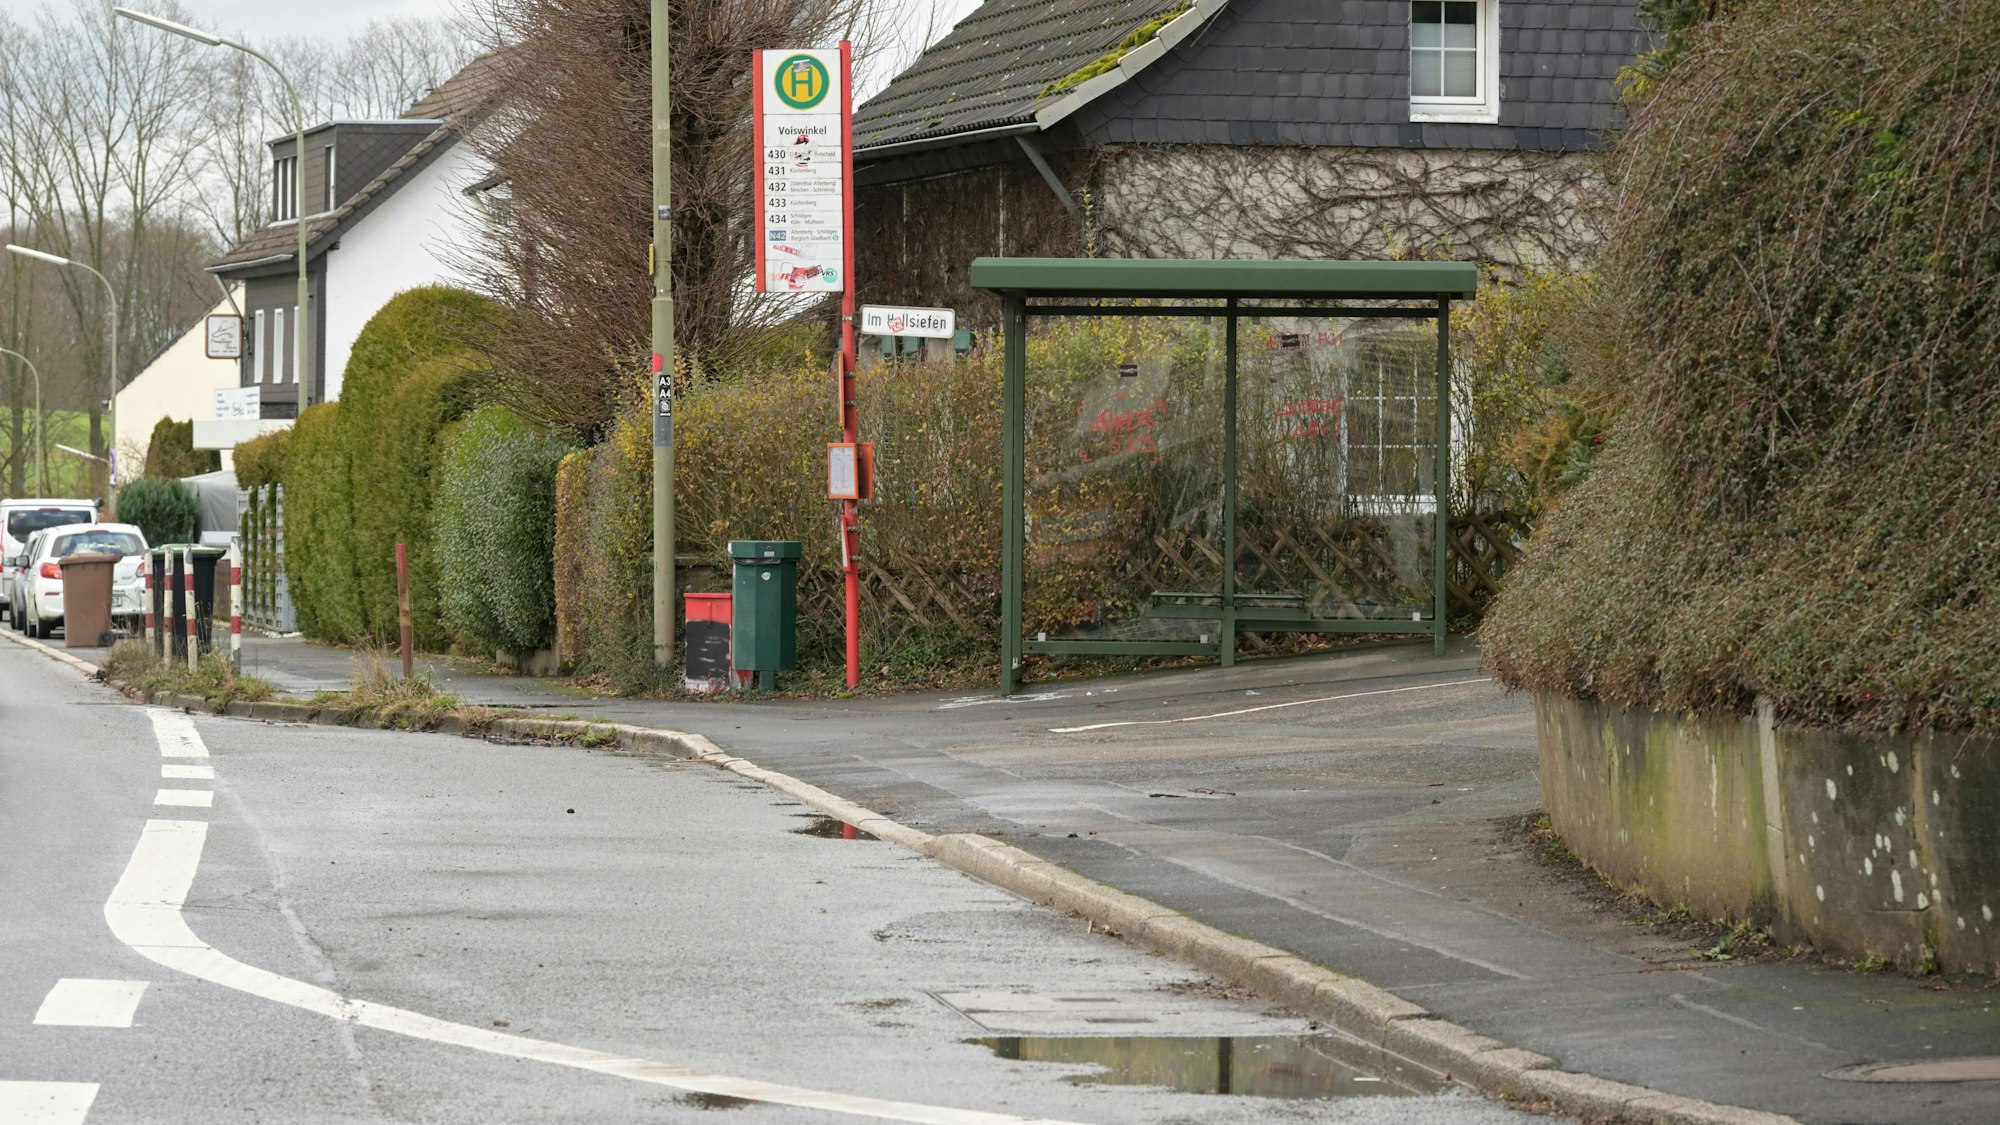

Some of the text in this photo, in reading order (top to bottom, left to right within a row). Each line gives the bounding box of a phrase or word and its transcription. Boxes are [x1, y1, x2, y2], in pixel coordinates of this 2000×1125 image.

[778, 126, 827, 135] Voiswinkel
[768, 150, 786, 159] 430
[768, 166, 785, 175] 431
[769, 182, 786, 192] 432
[769, 198, 786, 208] 433
[769, 214, 787, 224] 434
[769, 231, 787, 240] N42
[867, 312, 881, 326] Im
[659, 377, 671, 386] A3
[659, 389, 671, 398] A4
